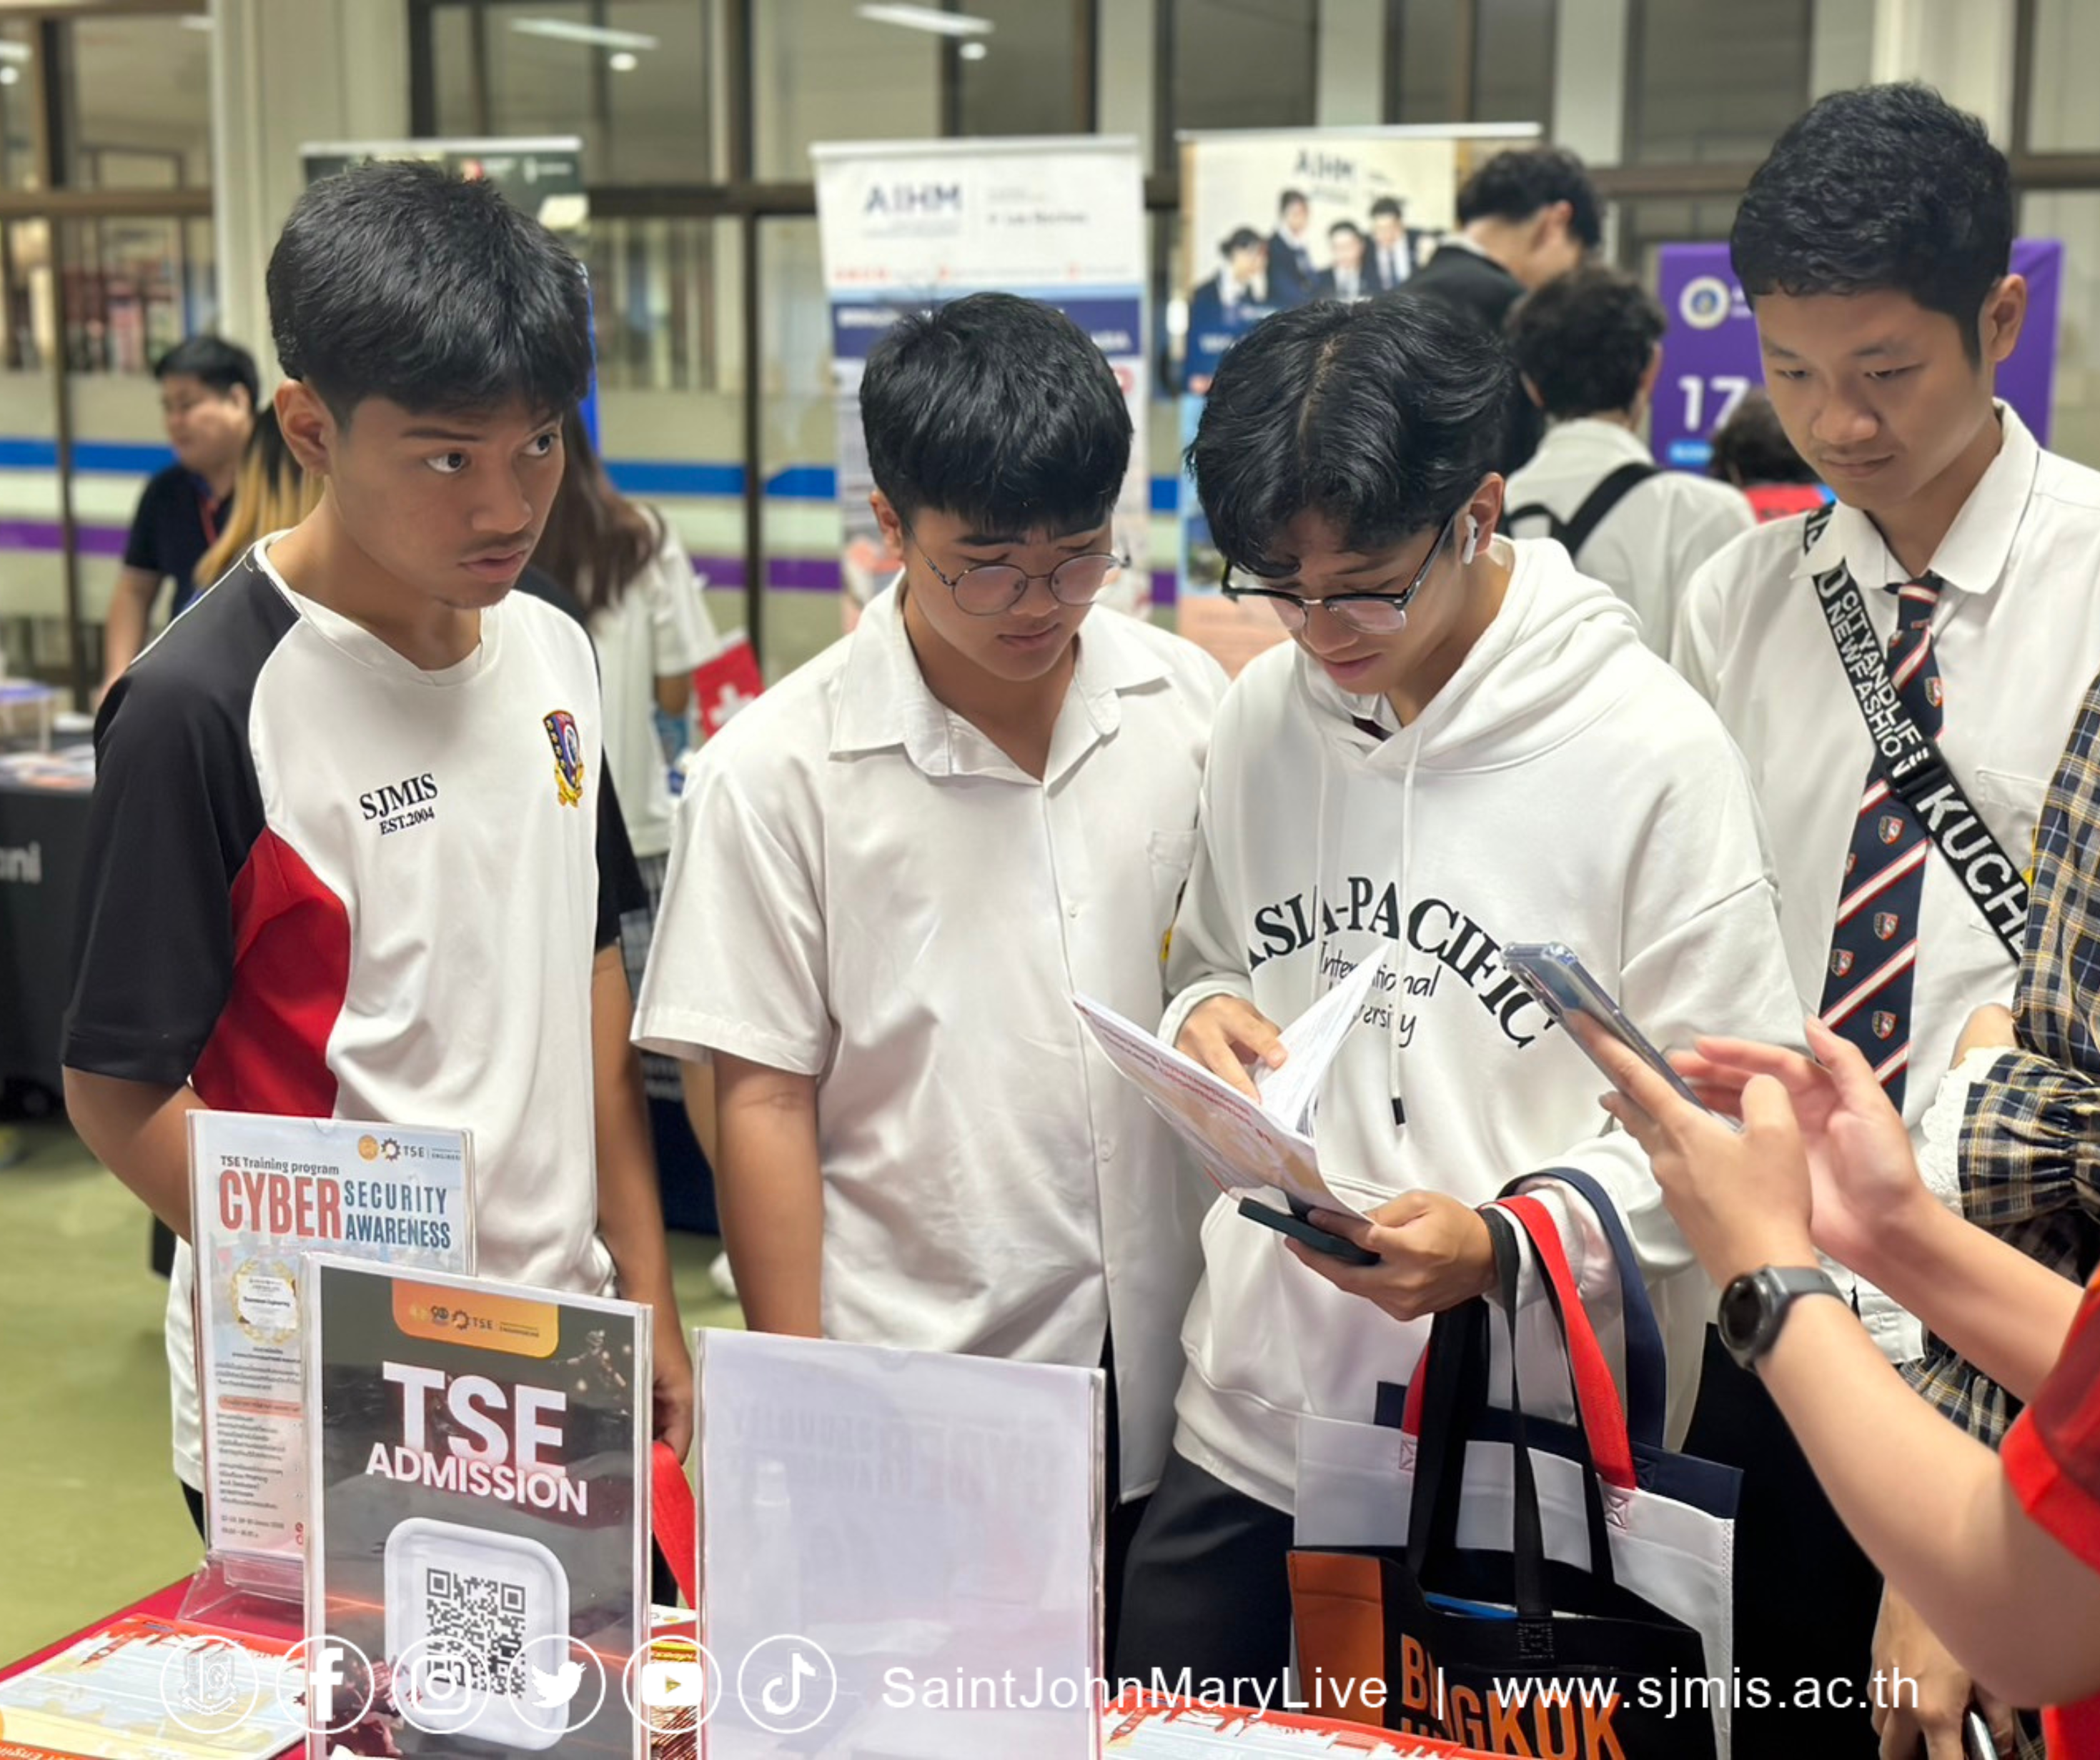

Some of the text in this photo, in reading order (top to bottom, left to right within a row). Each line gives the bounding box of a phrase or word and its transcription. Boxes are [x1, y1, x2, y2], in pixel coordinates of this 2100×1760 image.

[864, 182, 962, 216] AIHM
[360, 772, 438, 820] SJMIS
[379, 806, 435, 835] EST.2004
[1248, 876, 1556, 1049] SIA-PACIFIC
[220, 1155, 340, 1175] TSE Training program
[403, 1145, 425, 1158] TSE
[219, 1169, 447, 1239] CYBER SECURITY
[345, 1213, 452, 1249] AWARENESS
[472, 1316, 494, 1330] TSE
[382, 1361, 568, 1478] TSE
[365, 1441, 588, 1516] ADMISSION
